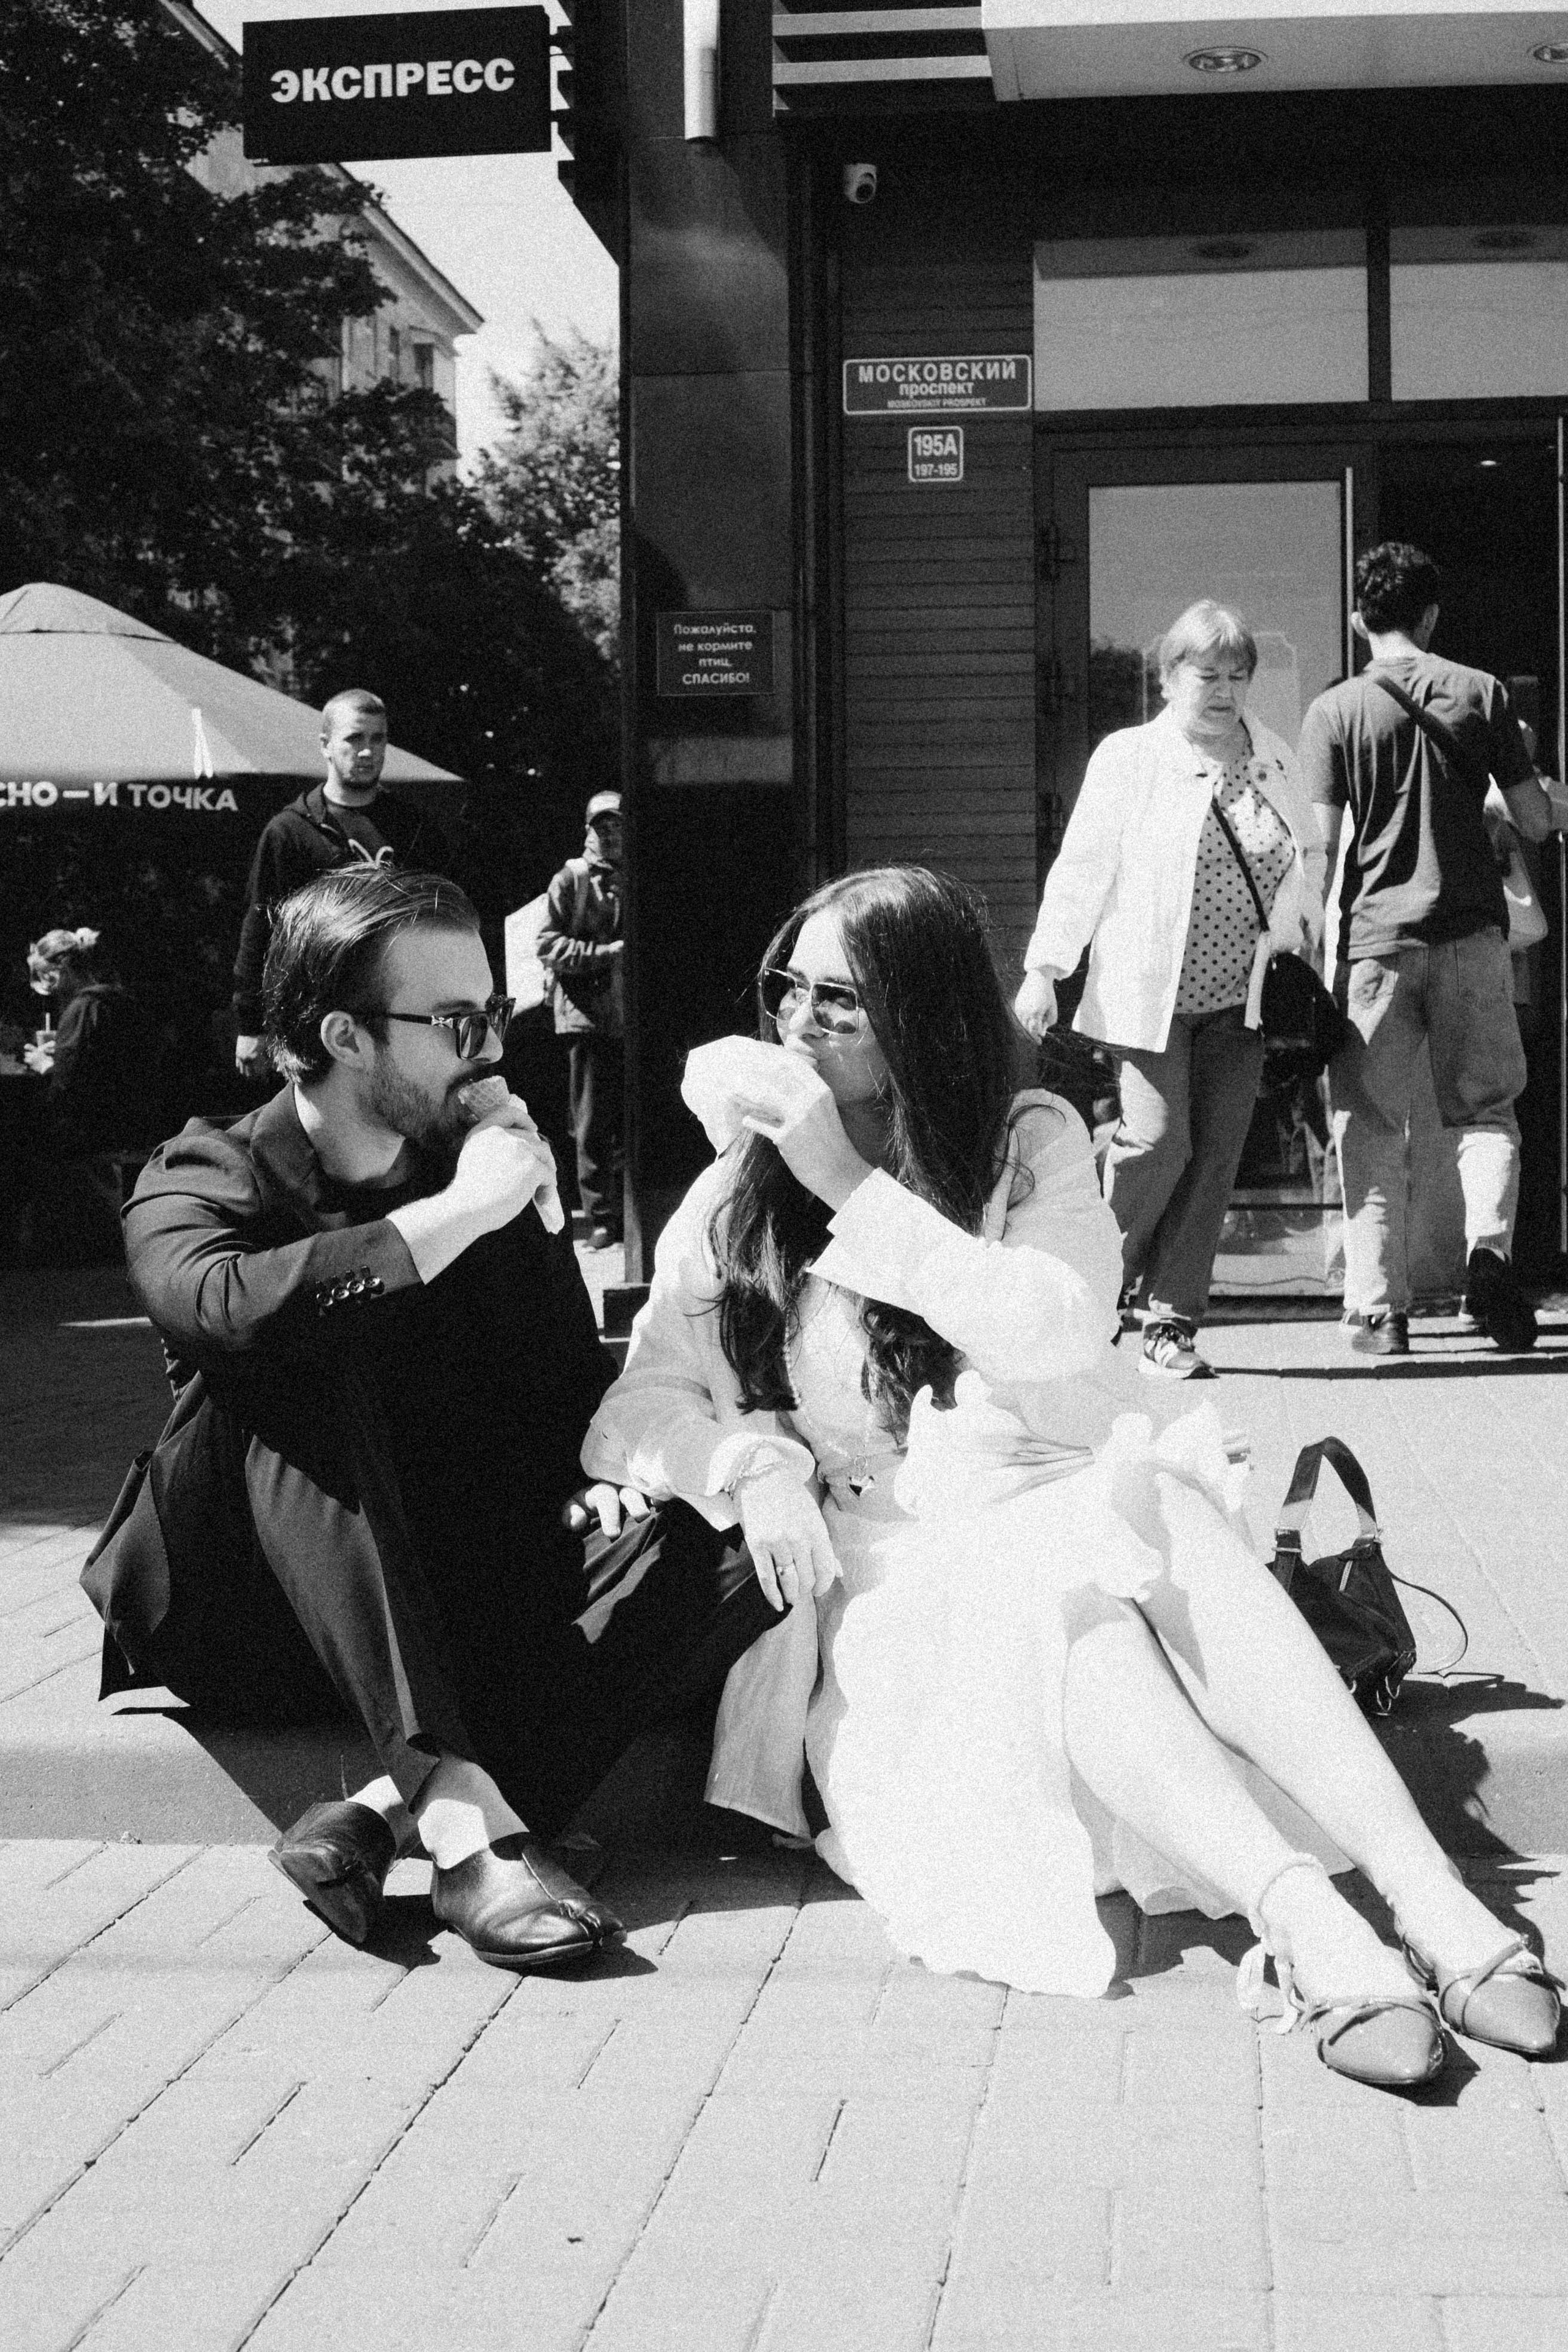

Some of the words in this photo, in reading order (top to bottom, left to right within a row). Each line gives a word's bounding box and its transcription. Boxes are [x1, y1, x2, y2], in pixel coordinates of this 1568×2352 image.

[270, 58, 515, 103] ЭКСПРЕСС
[858, 360, 1016, 383] МОСКОВСКИЙ
[899, 382, 974, 398] проспект
[913, 462, 958, 477] 197-195
[678, 643, 694, 652] не
[697, 641, 753, 653] кормите
[682, 673, 750, 685] СПАСИБО!
[93, 782, 118, 806] И
[127, 783, 239, 812] ТОЧКА
